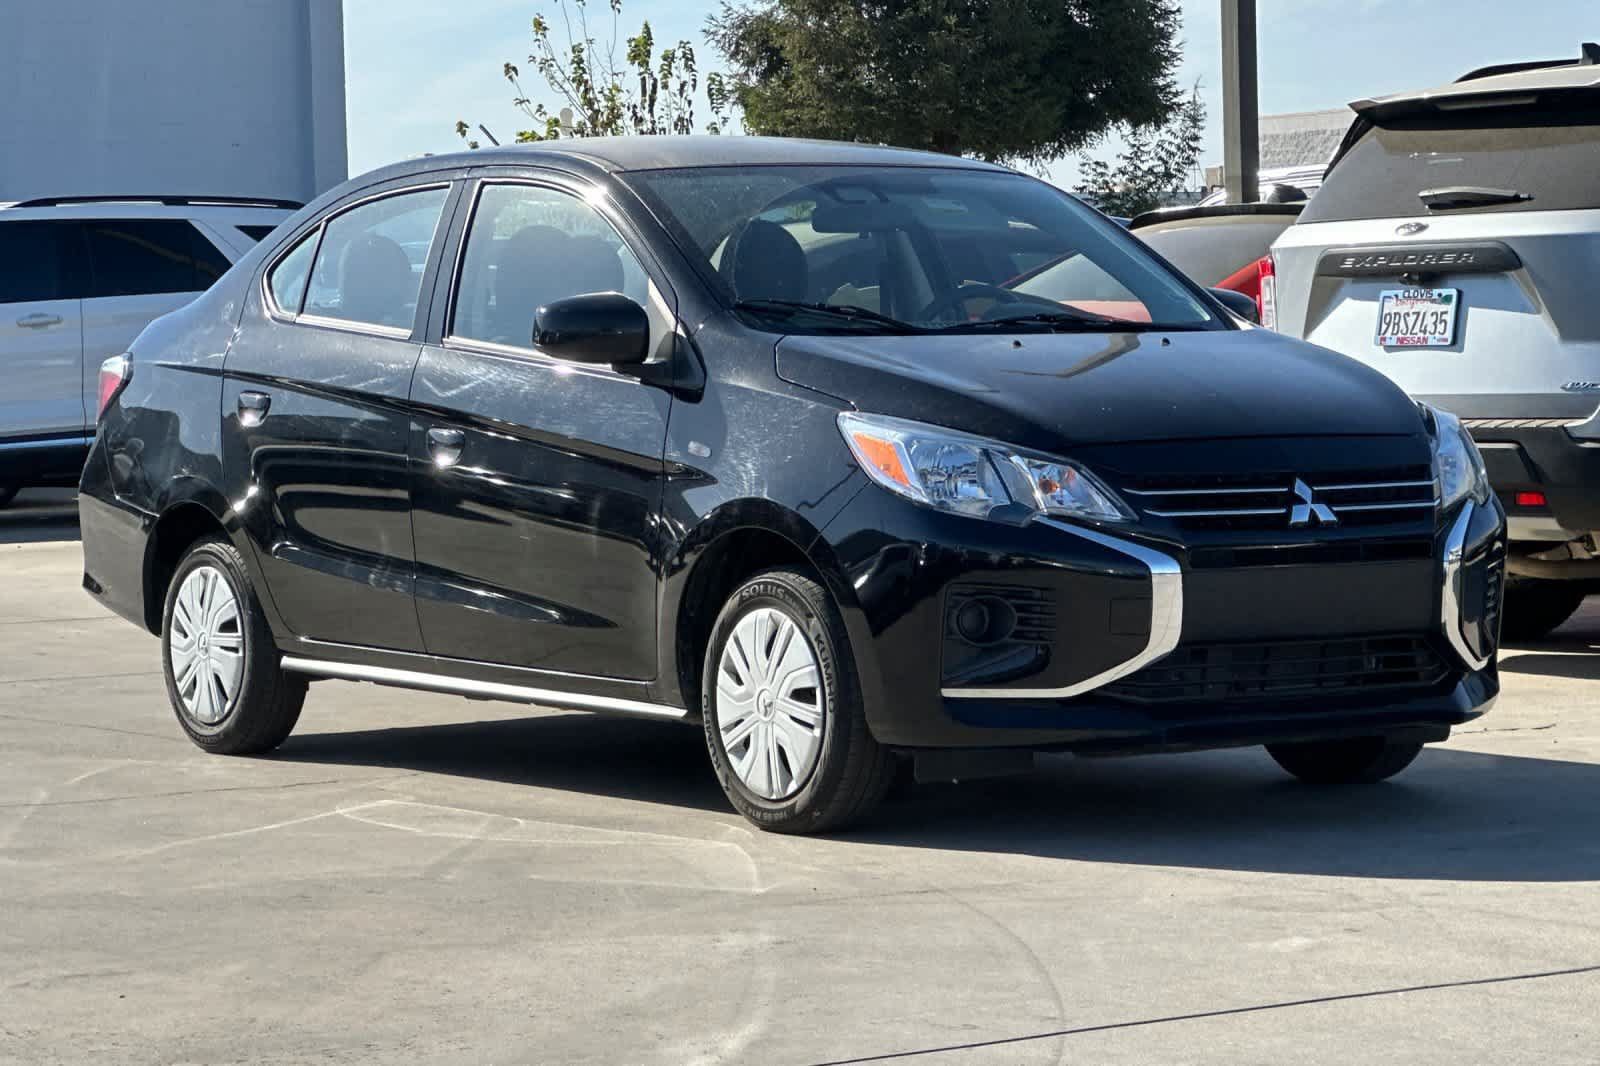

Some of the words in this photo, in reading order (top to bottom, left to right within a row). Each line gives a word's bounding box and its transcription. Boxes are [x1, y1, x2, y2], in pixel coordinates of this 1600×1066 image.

[1340, 252, 1474, 269] EXPLORER
[1402, 289, 1434, 299] CLOVIS
[1382, 311, 1448, 336] 9BSZ435
[1395, 336, 1430, 345] NISSAN
[742, 584, 785, 602] SOLUS
[814, 632, 836, 713] KUMHO
